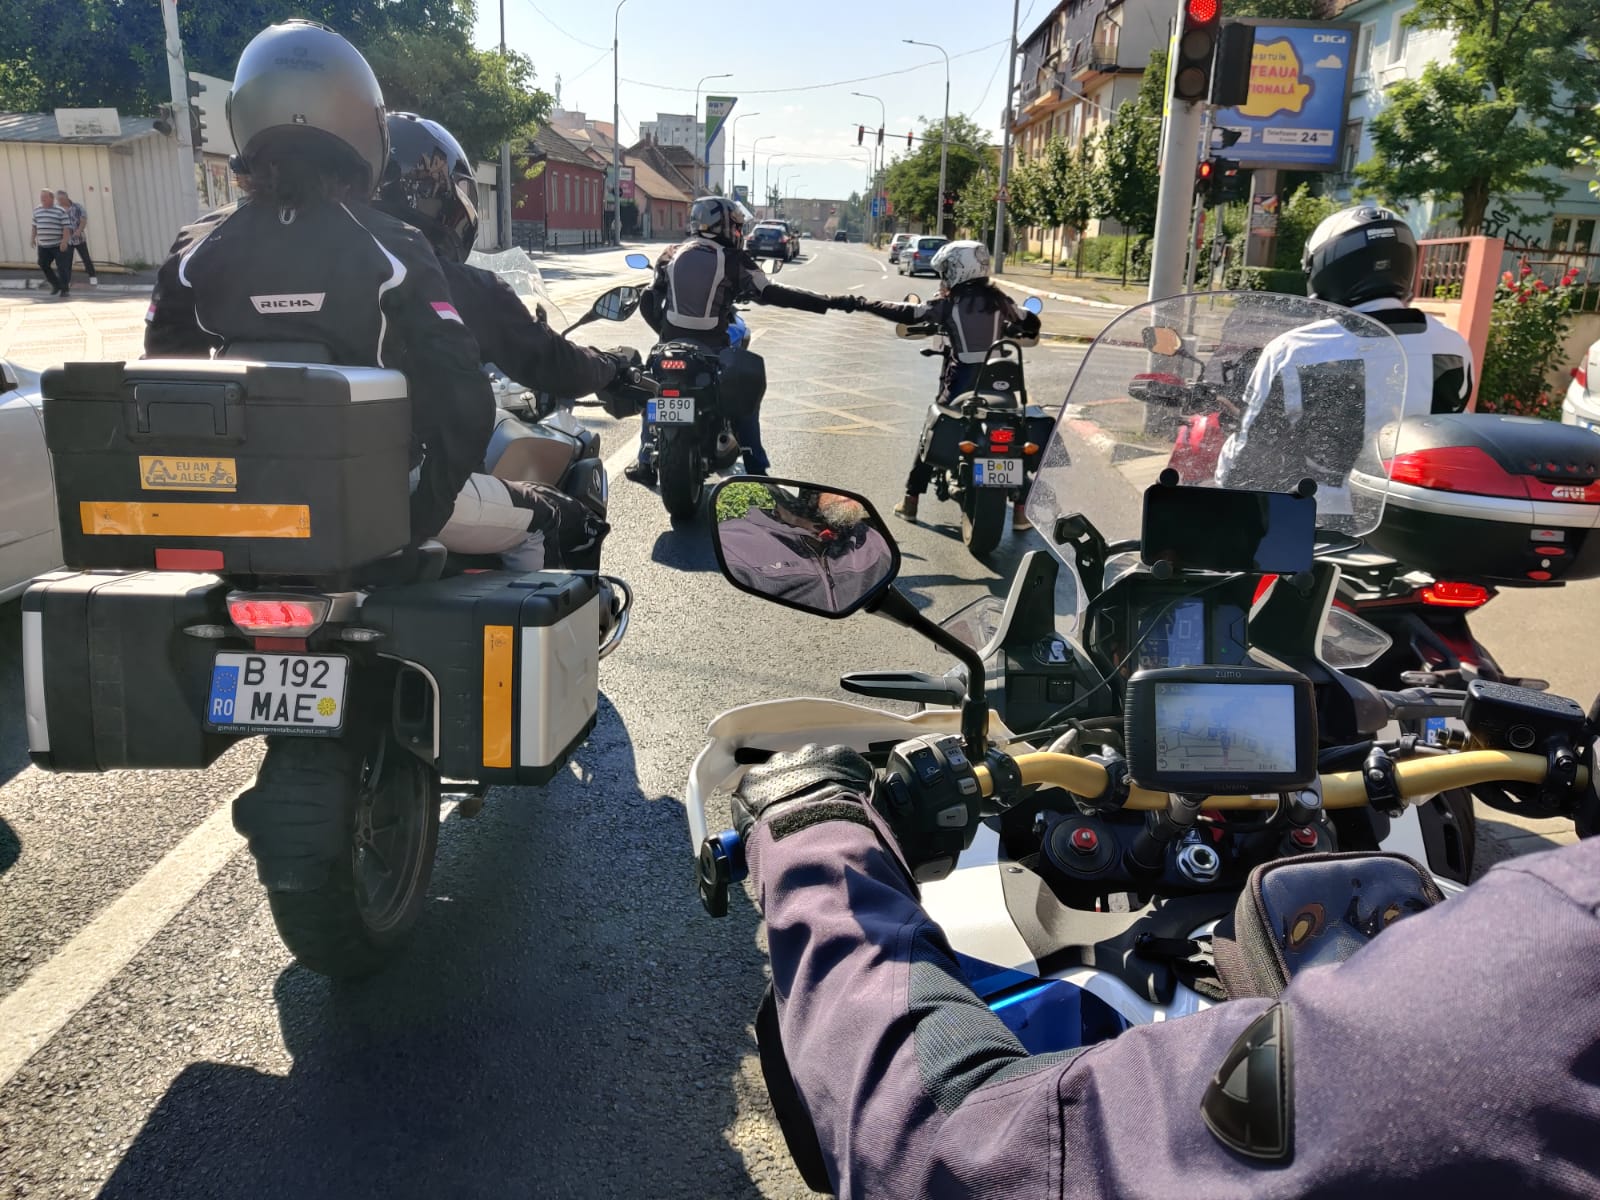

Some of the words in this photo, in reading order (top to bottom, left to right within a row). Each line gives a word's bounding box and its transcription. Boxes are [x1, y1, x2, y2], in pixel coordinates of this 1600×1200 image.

[1313, 34, 1347, 43] DIGI
[1301, 132, 1318, 142] 24
[260, 300, 315, 308] RICHA
[657, 400, 665, 409] B
[669, 400, 690, 409] 690
[660, 411, 684, 421] ROL
[176, 462, 191, 471] EU
[193, 463, 210, 471] AM
[987, 461, 995, 471] B
[1003, 461, 1014, 471] 10
[180, 473, 207, 482] ALES
[989, 473, 1013, 483] ROL
[1551, 485, 1585, 500] GIVI
[244, 657, 266, 685] B
[279, 658, 330, 688] 192
[213, 698, 234, 716] RO
[250, 691, 317, 723] MAE
